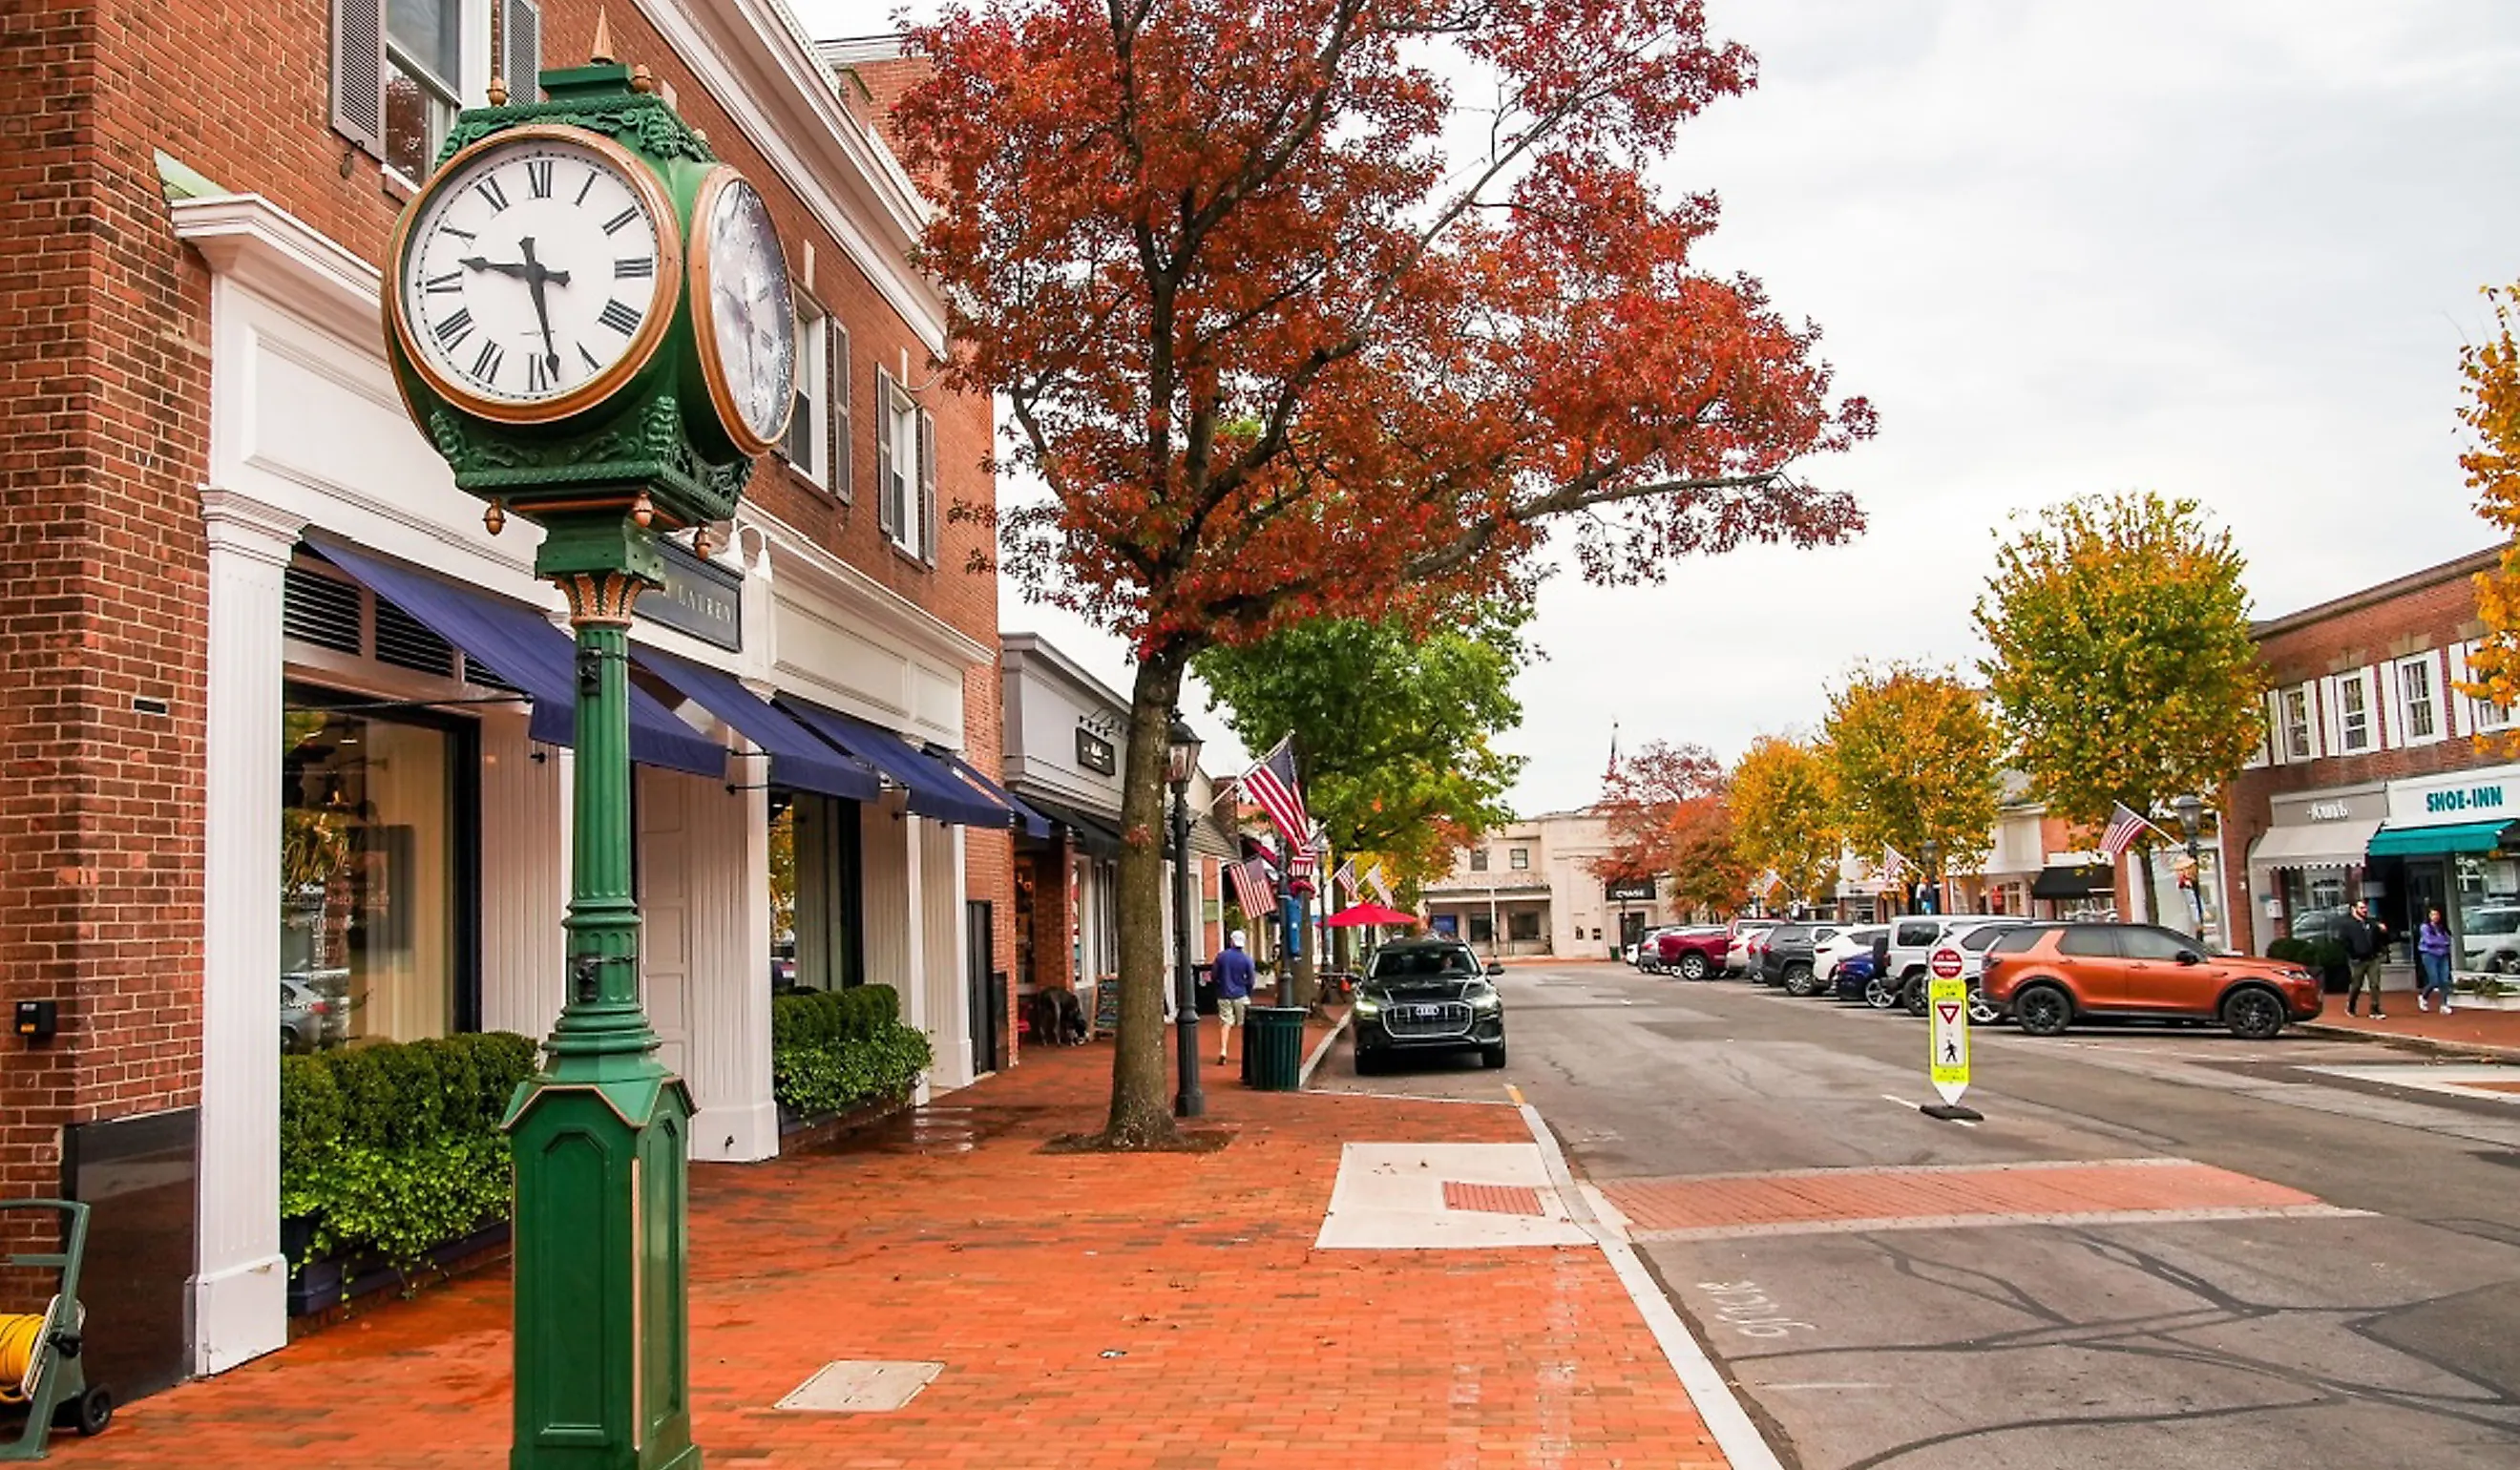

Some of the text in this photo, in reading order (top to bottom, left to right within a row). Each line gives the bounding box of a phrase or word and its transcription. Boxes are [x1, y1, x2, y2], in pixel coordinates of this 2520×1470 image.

[475, 174, 511, 219] XI
[525, 160, 554, 200] XII
[571, 169, 601, 207] I
[438, 217, 478, 249] X
[600, 203, 640, 239] II
[426, 268, 464, 294] IX
[614, 257, 653, 279] III
[434, 304, 475, 353] VIII
[596, 296, 643, 341] IIII
[468, 337, 506, 386] VII
[576, 340, 603, 376] V
[678, 584, 731, 623] LAUREN
